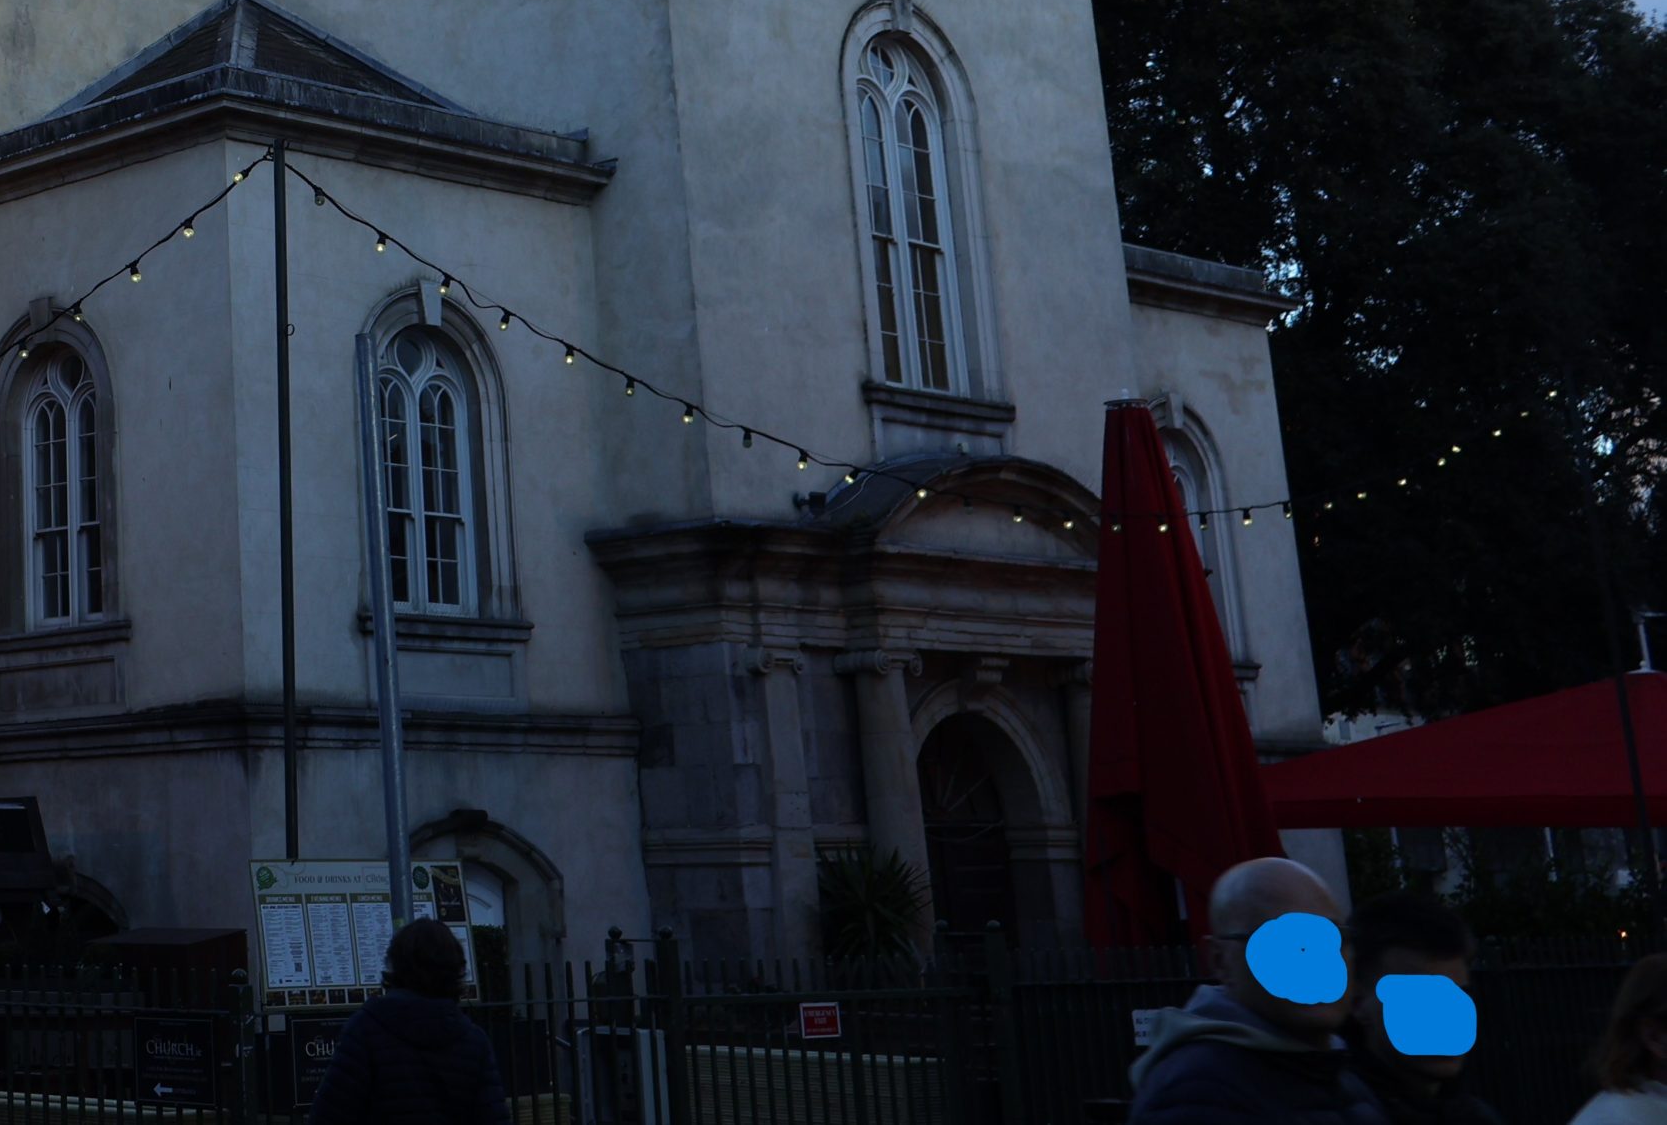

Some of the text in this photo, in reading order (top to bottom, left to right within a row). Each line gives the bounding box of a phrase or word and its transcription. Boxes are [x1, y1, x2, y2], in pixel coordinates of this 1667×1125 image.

[294, 875, 316, 884] FOOD
[325, 875, 352, 884] DRINKS
[305, 1039, 335, 1057] CHU
